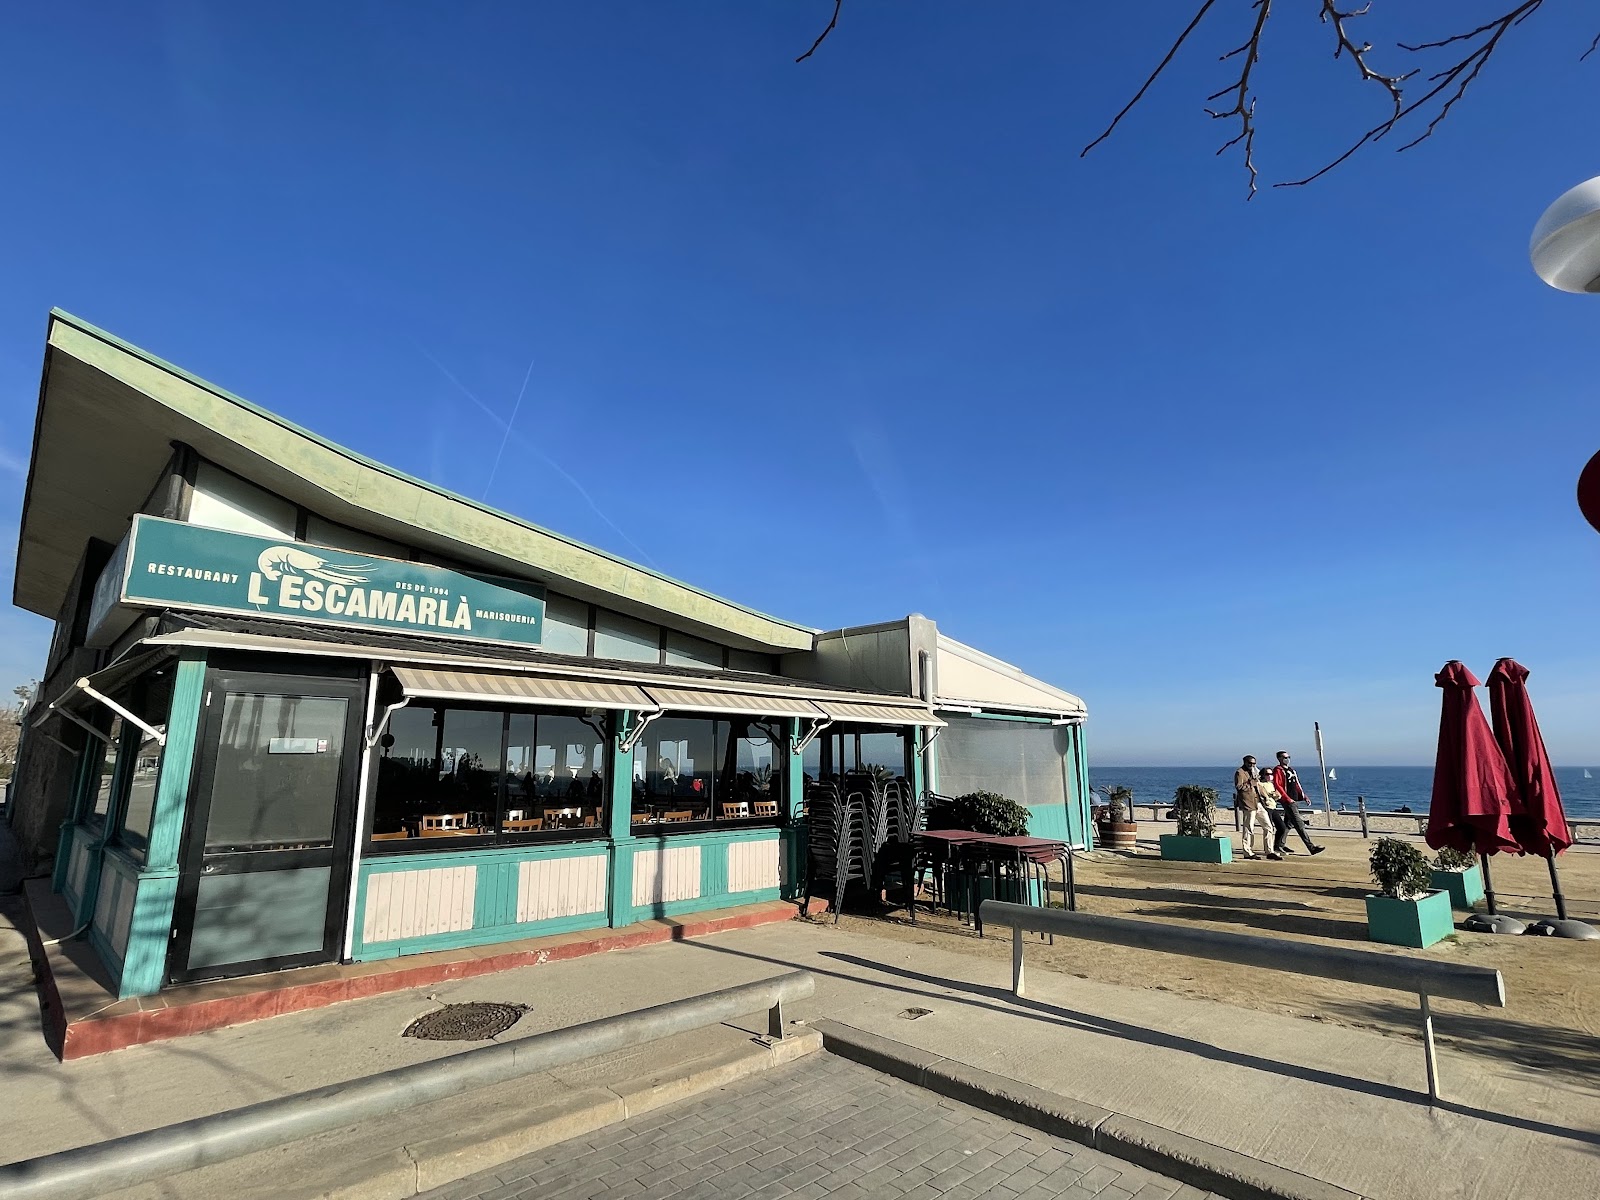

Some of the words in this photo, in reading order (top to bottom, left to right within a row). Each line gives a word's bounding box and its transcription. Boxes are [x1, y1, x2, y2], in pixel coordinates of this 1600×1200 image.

[148, 562, 239, 584] RESTAURANT
[429, 586, 449, 596] 1994
[475, 609, 536, 625] MARISQUERIA
